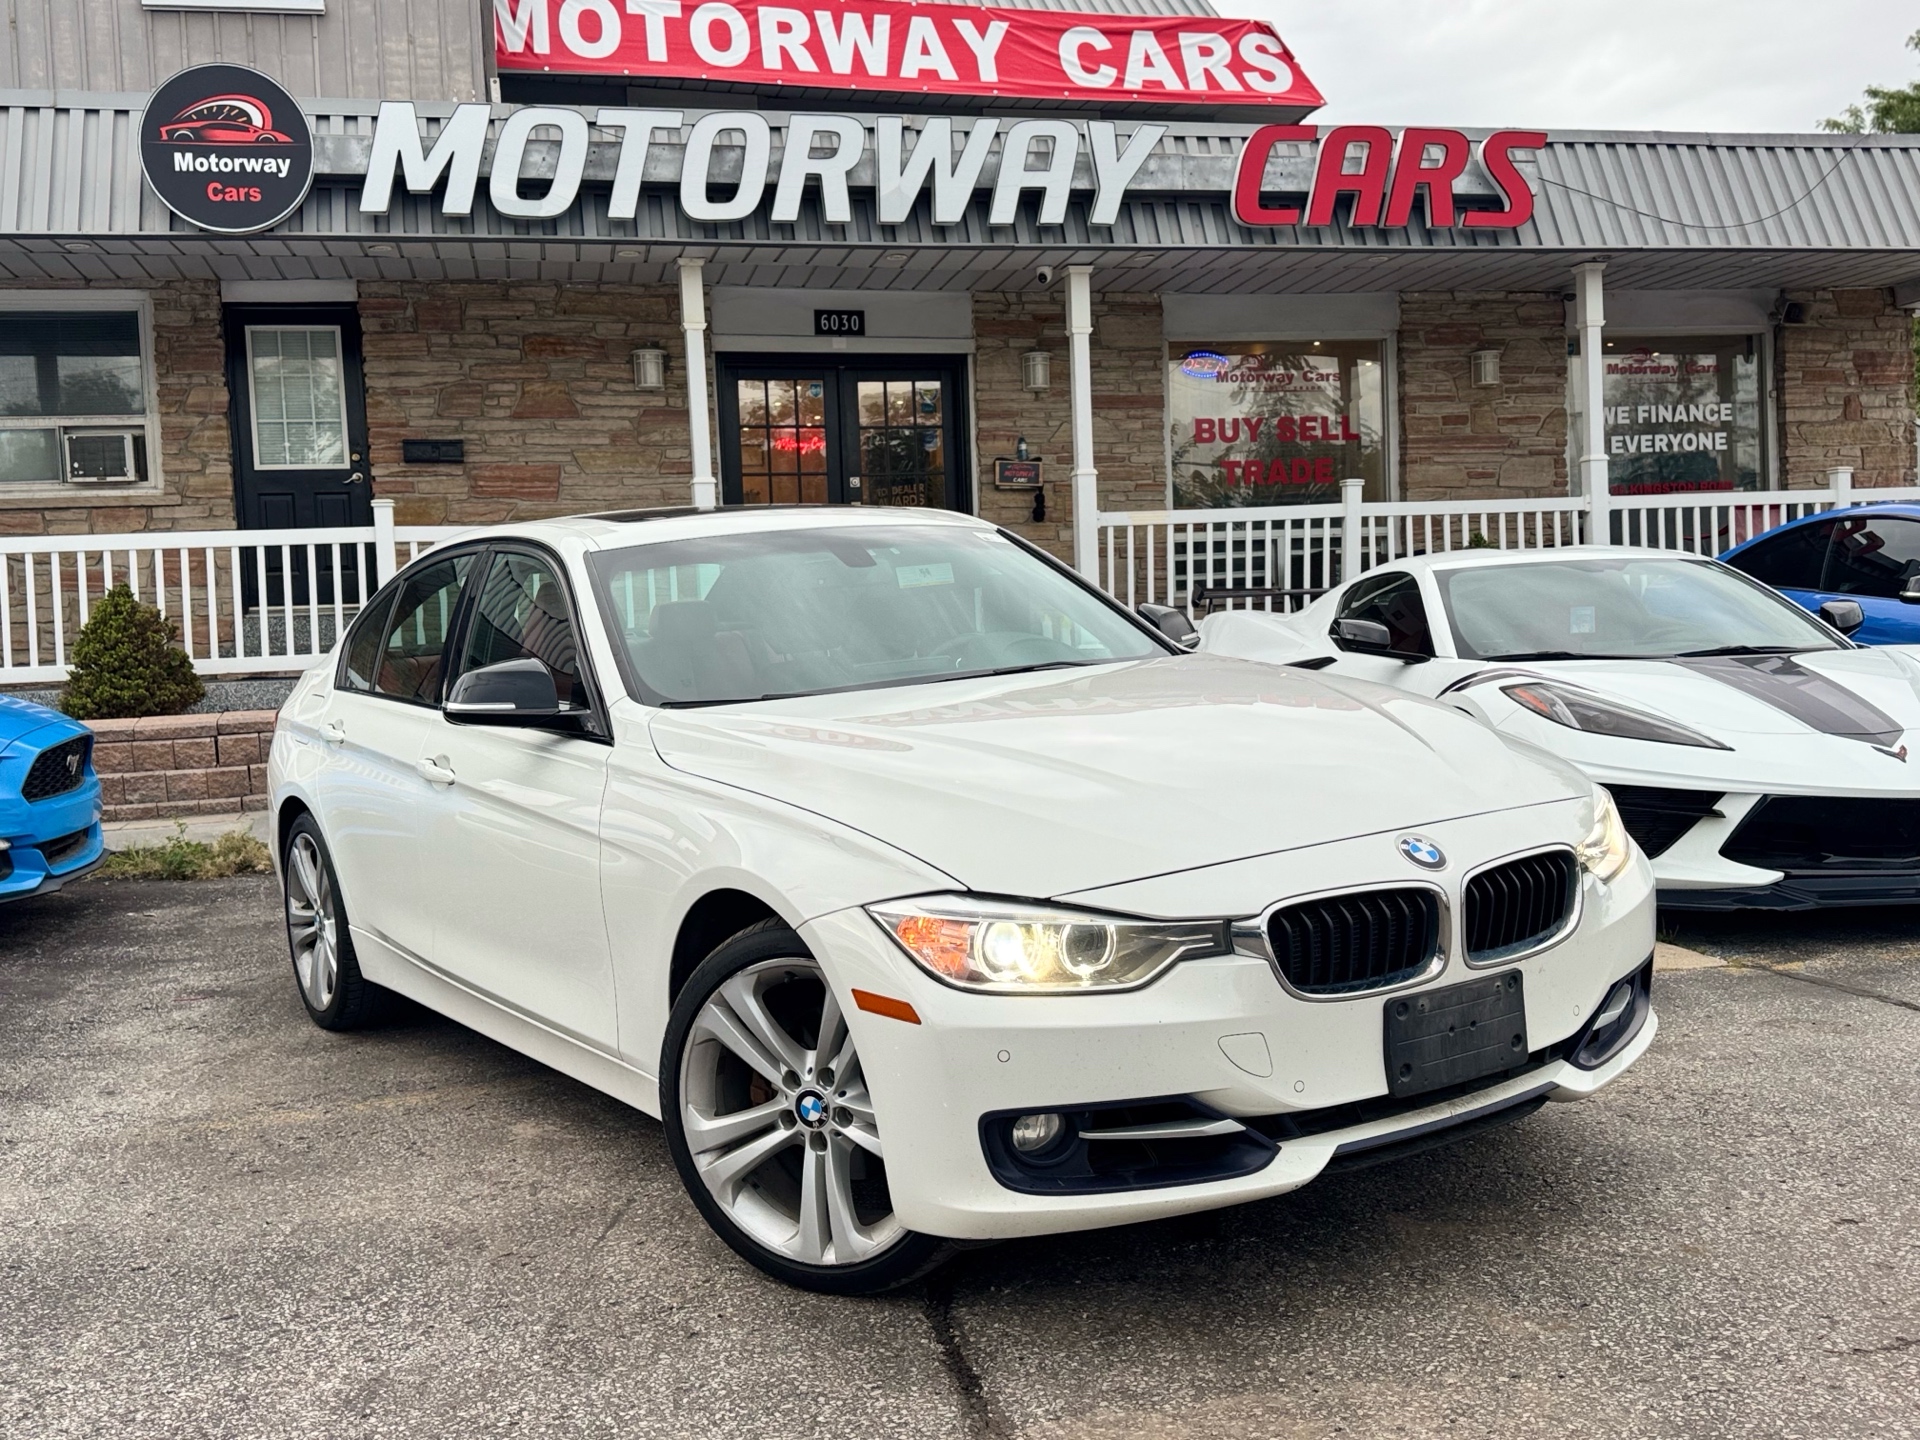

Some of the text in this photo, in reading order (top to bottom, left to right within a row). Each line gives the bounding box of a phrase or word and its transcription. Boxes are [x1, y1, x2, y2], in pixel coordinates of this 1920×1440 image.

[494, 0, 1293, 94] MOTORWAY CARS
[173, 152, 291, 178] Motorway
[359, 101, 1548, 230] MOTORWAY CARS
[207, 182, 262, 202] Cars
[821, 314, 859, 331] 6030
[1183, 358, 1229, 376] OPEN
[1216, 369, 1341, 385] Motorway Cars
[1606, 360, 1720, 377] Motorway Cars
[1603, 403, 1733, 425] WE FINANCE
[1194, 415, 1361, 444] BUY SELL
[1611, 432, 1728, 454] EVERYONE
[1220, 457, 1335, 486] TRADE
[1629, 482, 1696, 495] KINGSTON
